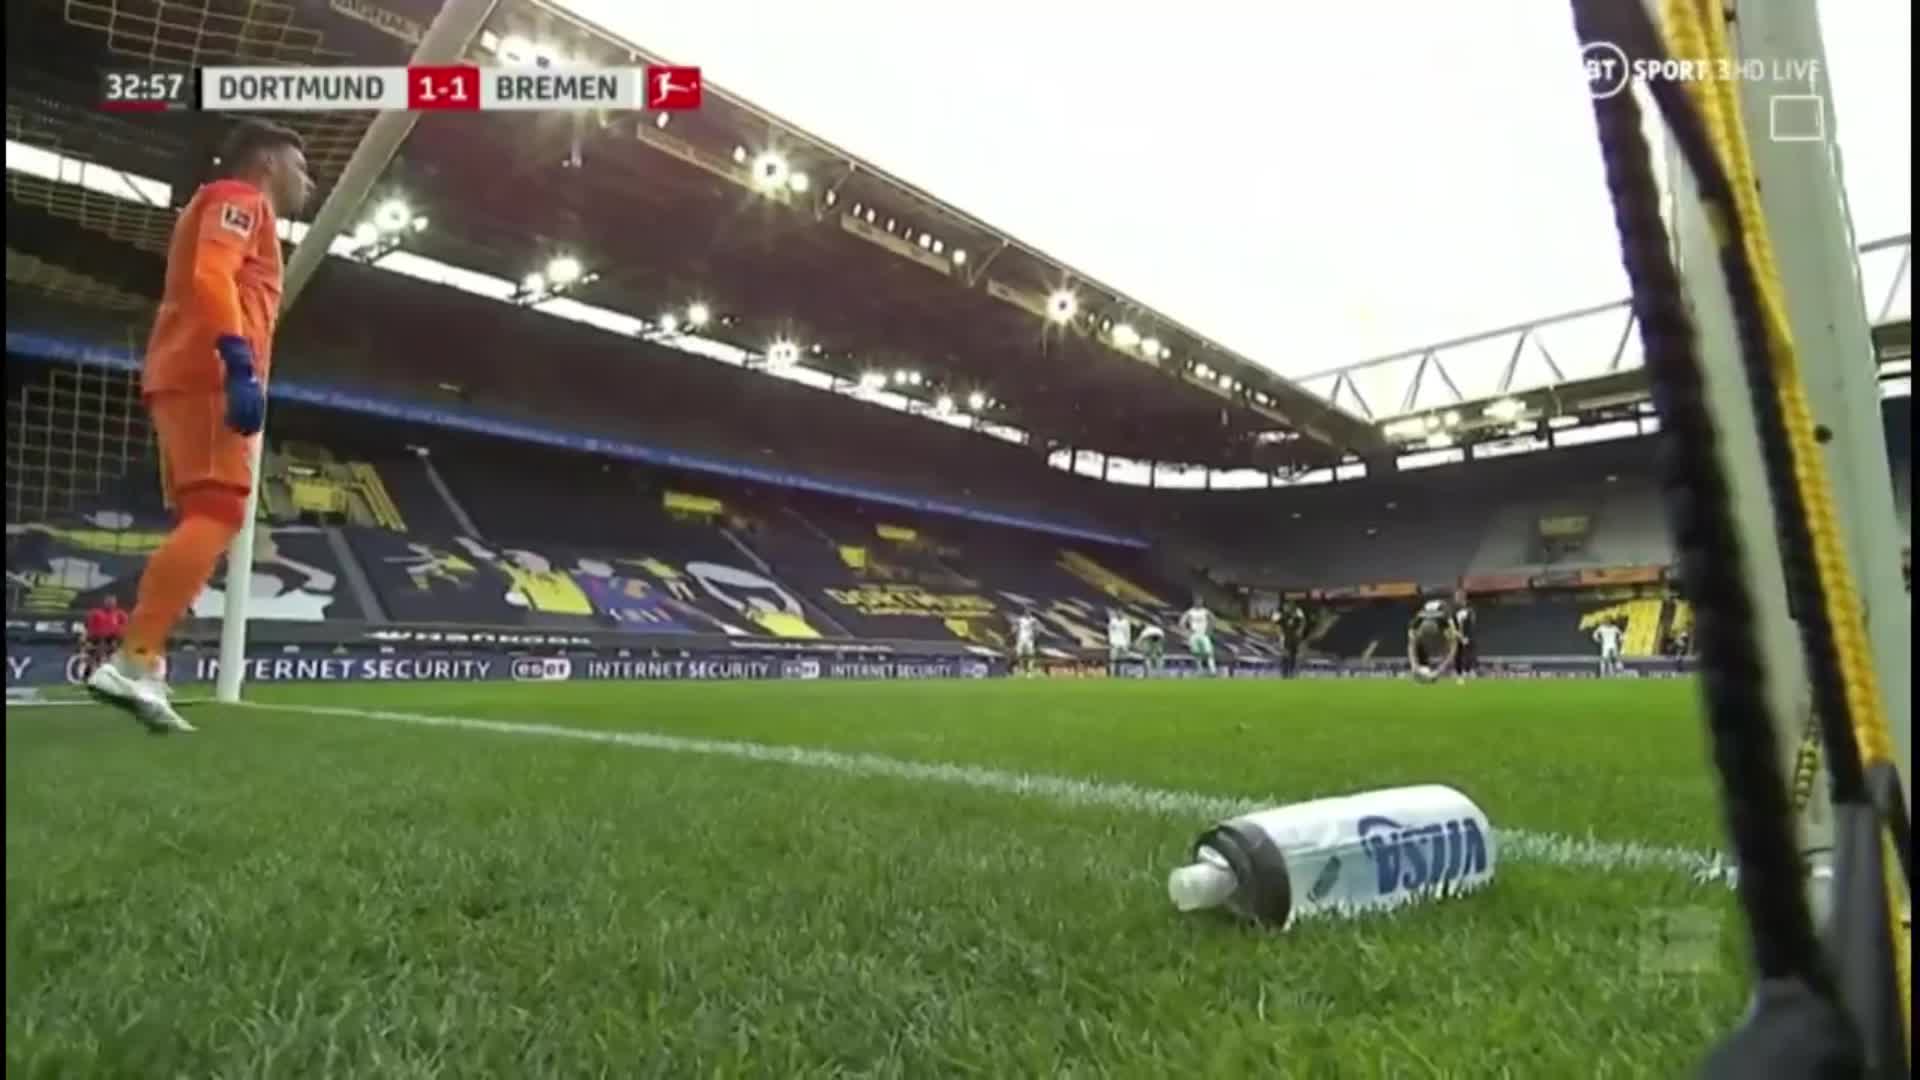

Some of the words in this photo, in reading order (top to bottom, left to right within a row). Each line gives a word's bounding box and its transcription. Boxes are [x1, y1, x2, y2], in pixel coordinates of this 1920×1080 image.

[361, 658, 491, 681] SECURITY
[588, 659, 684, 680] INTERNET
[688, 660, 770, 680] SECURITY
[1364, 817, 1487, 894] VILSA
